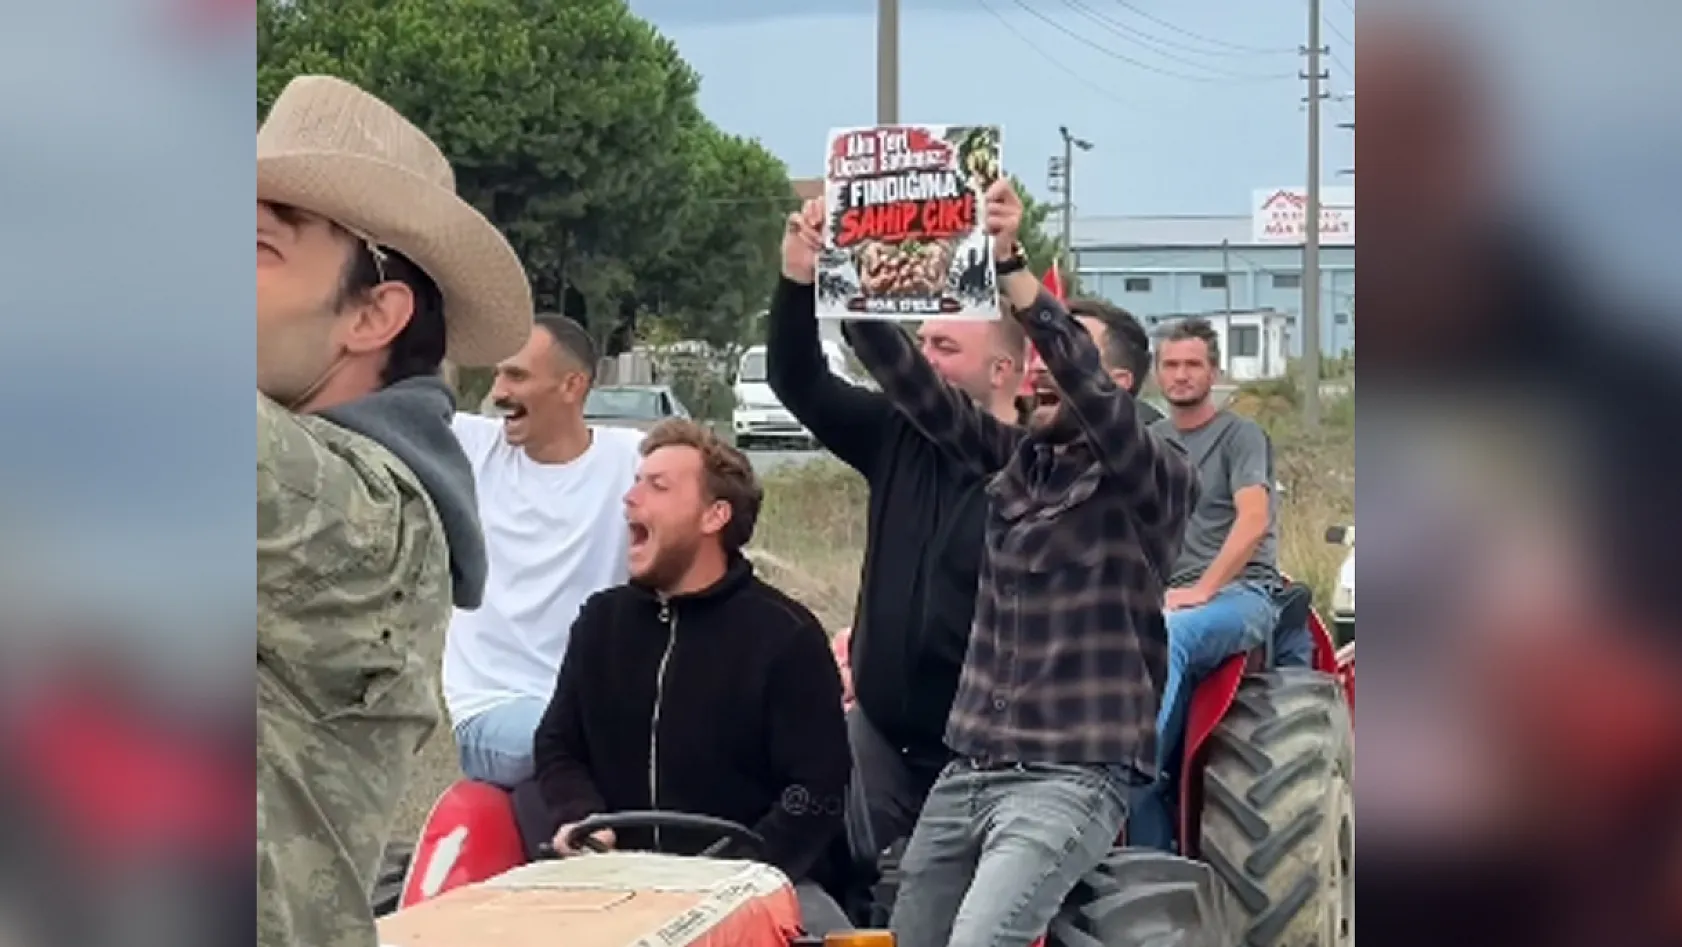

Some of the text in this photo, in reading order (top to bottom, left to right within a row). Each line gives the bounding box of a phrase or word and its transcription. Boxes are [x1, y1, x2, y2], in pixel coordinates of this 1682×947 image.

[850, 170, 959, 208] FINDIĞINA
[841, 191, 973, 245] SAHİP ÇIK!
